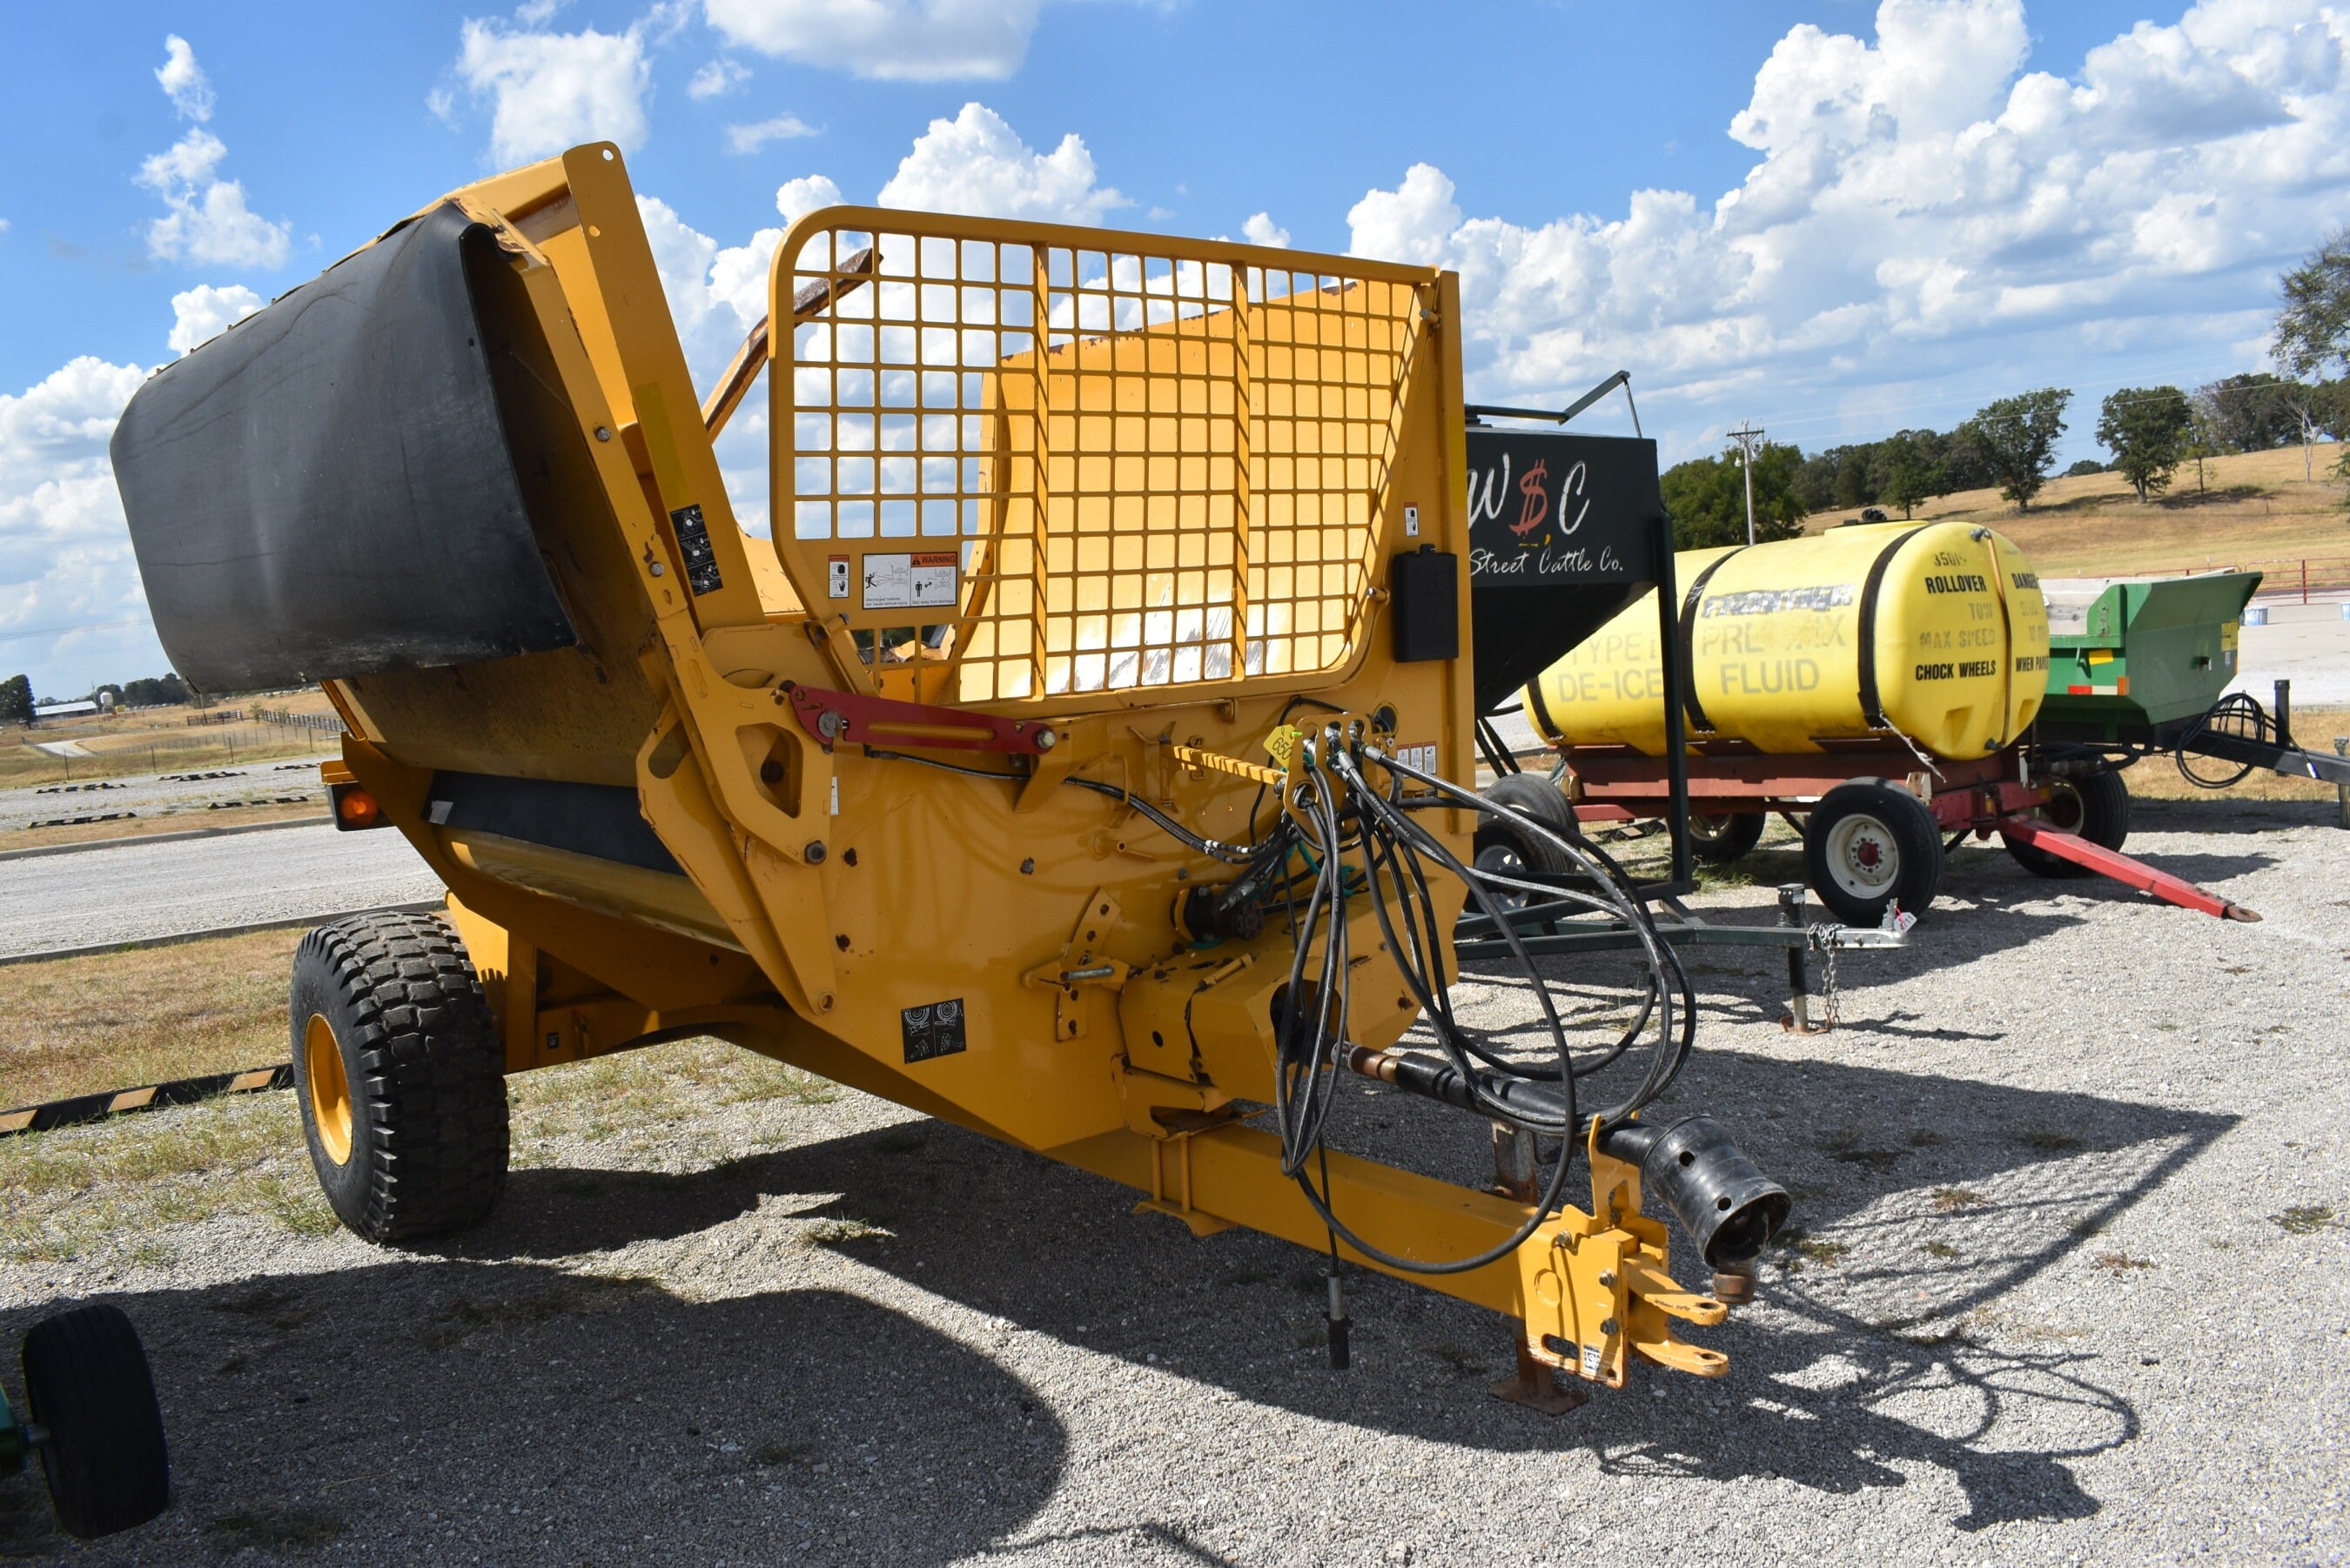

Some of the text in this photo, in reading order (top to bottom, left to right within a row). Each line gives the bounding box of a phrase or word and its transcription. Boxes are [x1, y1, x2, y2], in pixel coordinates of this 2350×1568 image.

[922, 555, 956, 565] WARNING
[1468, 545, 1624, 577] Street Cattle Co.
[1924, 574, 1988, 594] ROLLOVER
[1719, 657, 1821, 695] FLUID
[1915, 660, 1997, 681] CHOCK WHEELS
[1272, 737, 1292, 760] 650
